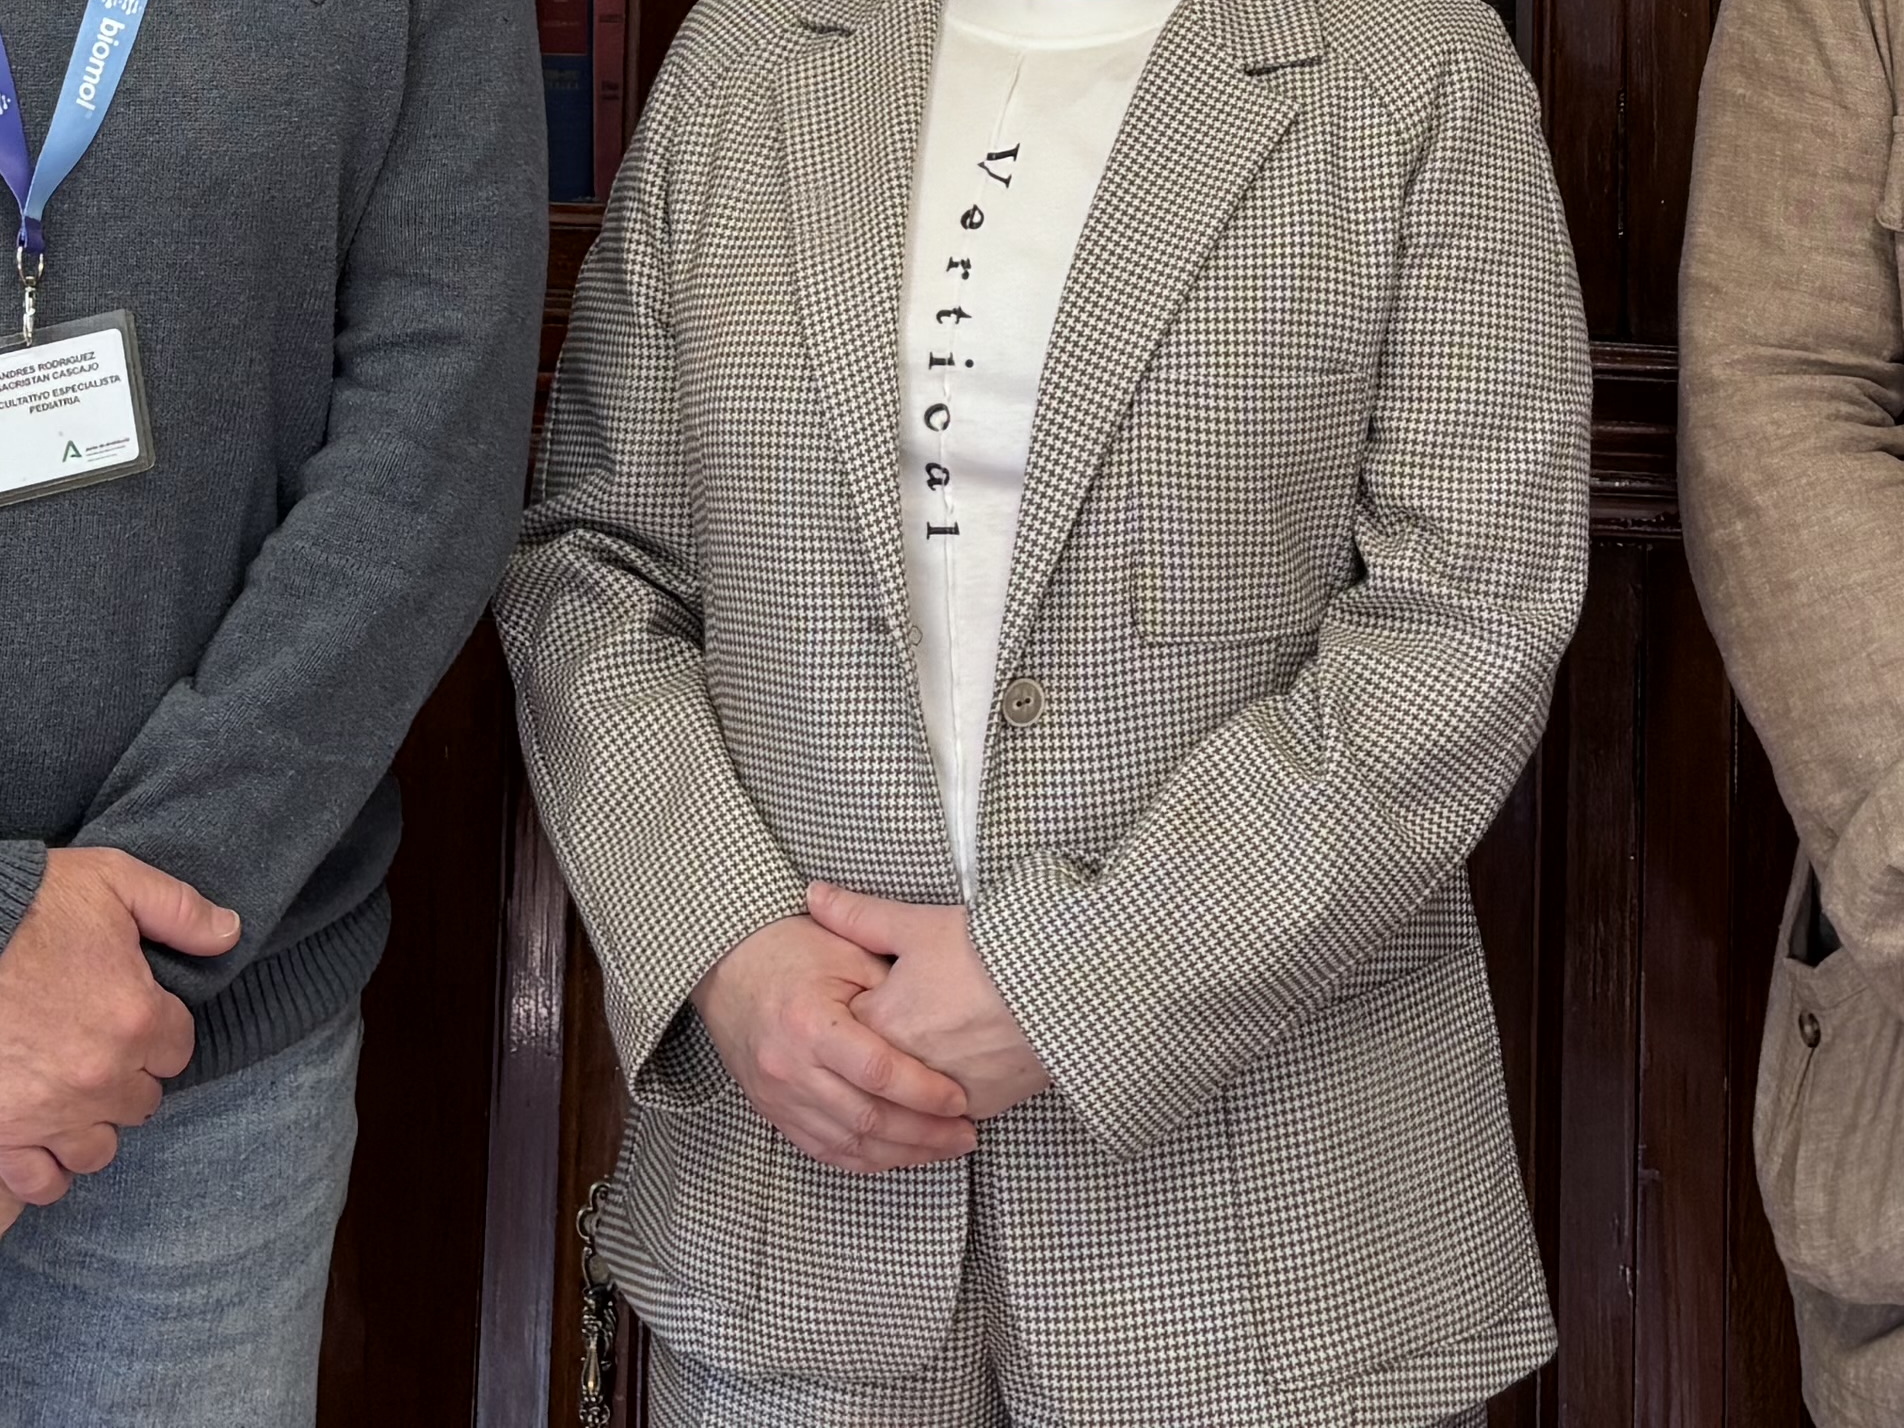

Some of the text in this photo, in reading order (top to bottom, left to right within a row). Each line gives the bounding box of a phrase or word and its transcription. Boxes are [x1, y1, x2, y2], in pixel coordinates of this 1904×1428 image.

[76, 16, 126, 112] biomol
[923, 143, 1020, 539] Vertical
[38, 351, 96, 372] RODRIGUEZ
[52, 362, 99, 380] CASCAJO
[52, 375, 121, 397] ESPECIALISTA
[29, 396, 81, 414] PEDIATRIA
